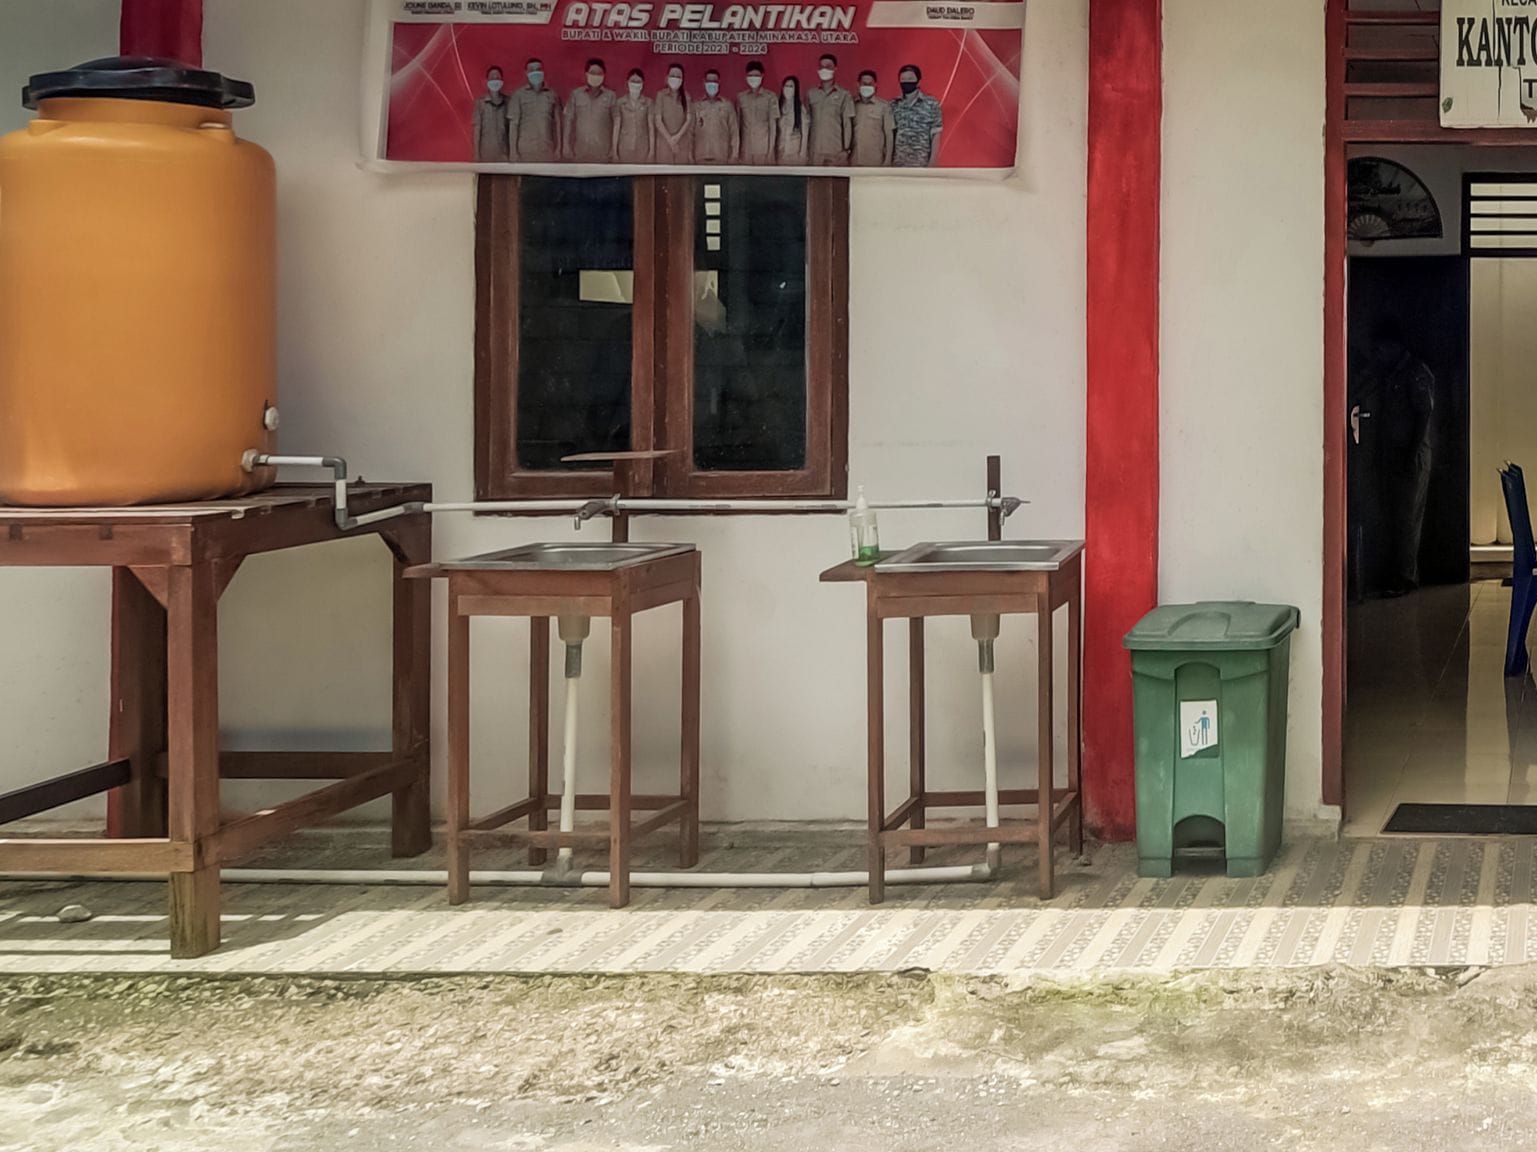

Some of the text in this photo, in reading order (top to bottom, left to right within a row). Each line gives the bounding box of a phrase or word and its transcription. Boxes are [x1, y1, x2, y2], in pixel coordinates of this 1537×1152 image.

[564, 2, 856, 29] ATAS PELANTIKAN
[562, 29, 859, 43] BUPATI & WAKIL BUPATI KABUPATEN MINAHASA UTARA
[654, 42, 702, 53] PERIODE
[703, 43, 729, 54] 2021
